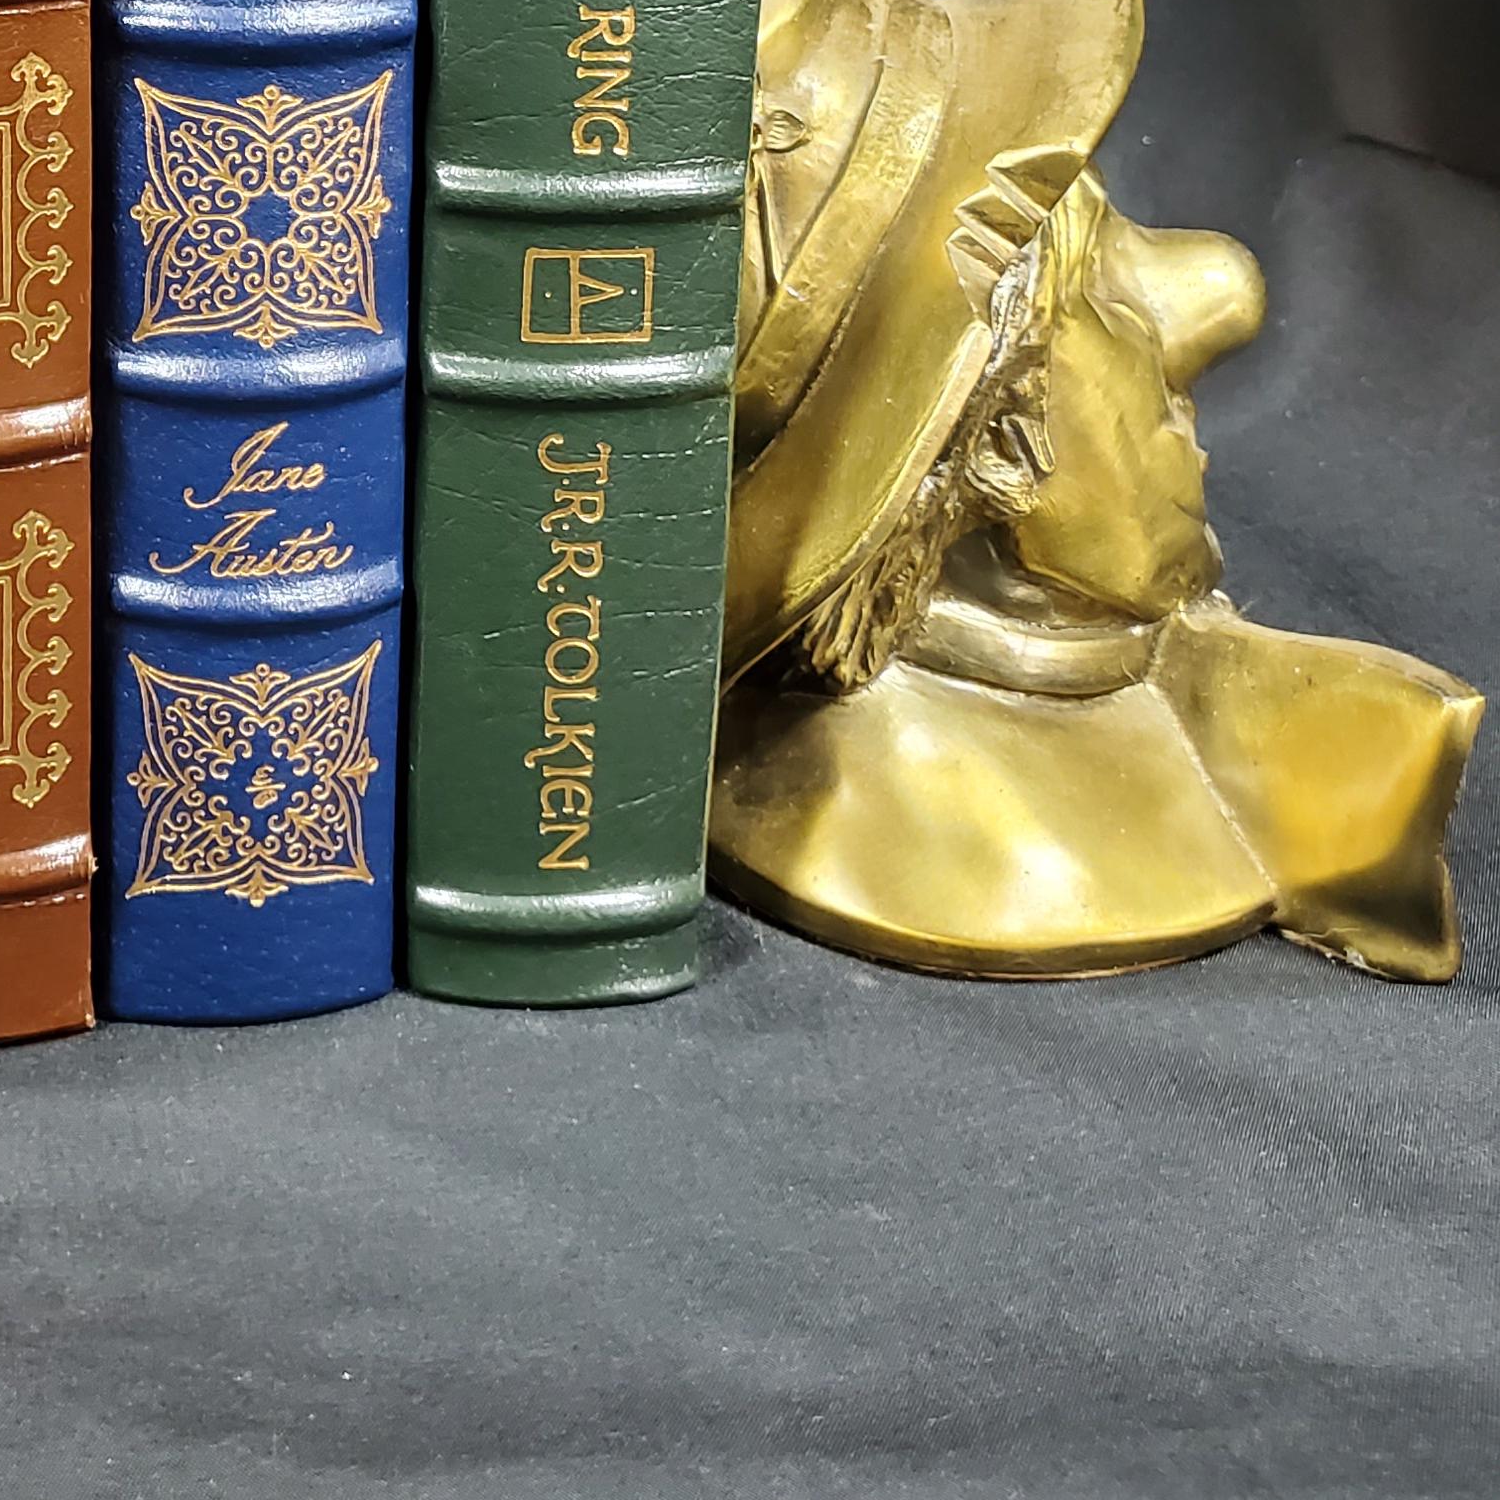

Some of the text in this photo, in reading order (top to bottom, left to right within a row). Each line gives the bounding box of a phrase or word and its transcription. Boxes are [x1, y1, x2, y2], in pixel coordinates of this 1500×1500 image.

[567, 5, 637, 156] RING
[183, 421, 328, 509] Jane
[149, 508, 354, 578] Austen
[523, 595, 603, 871] TOLKIEN
